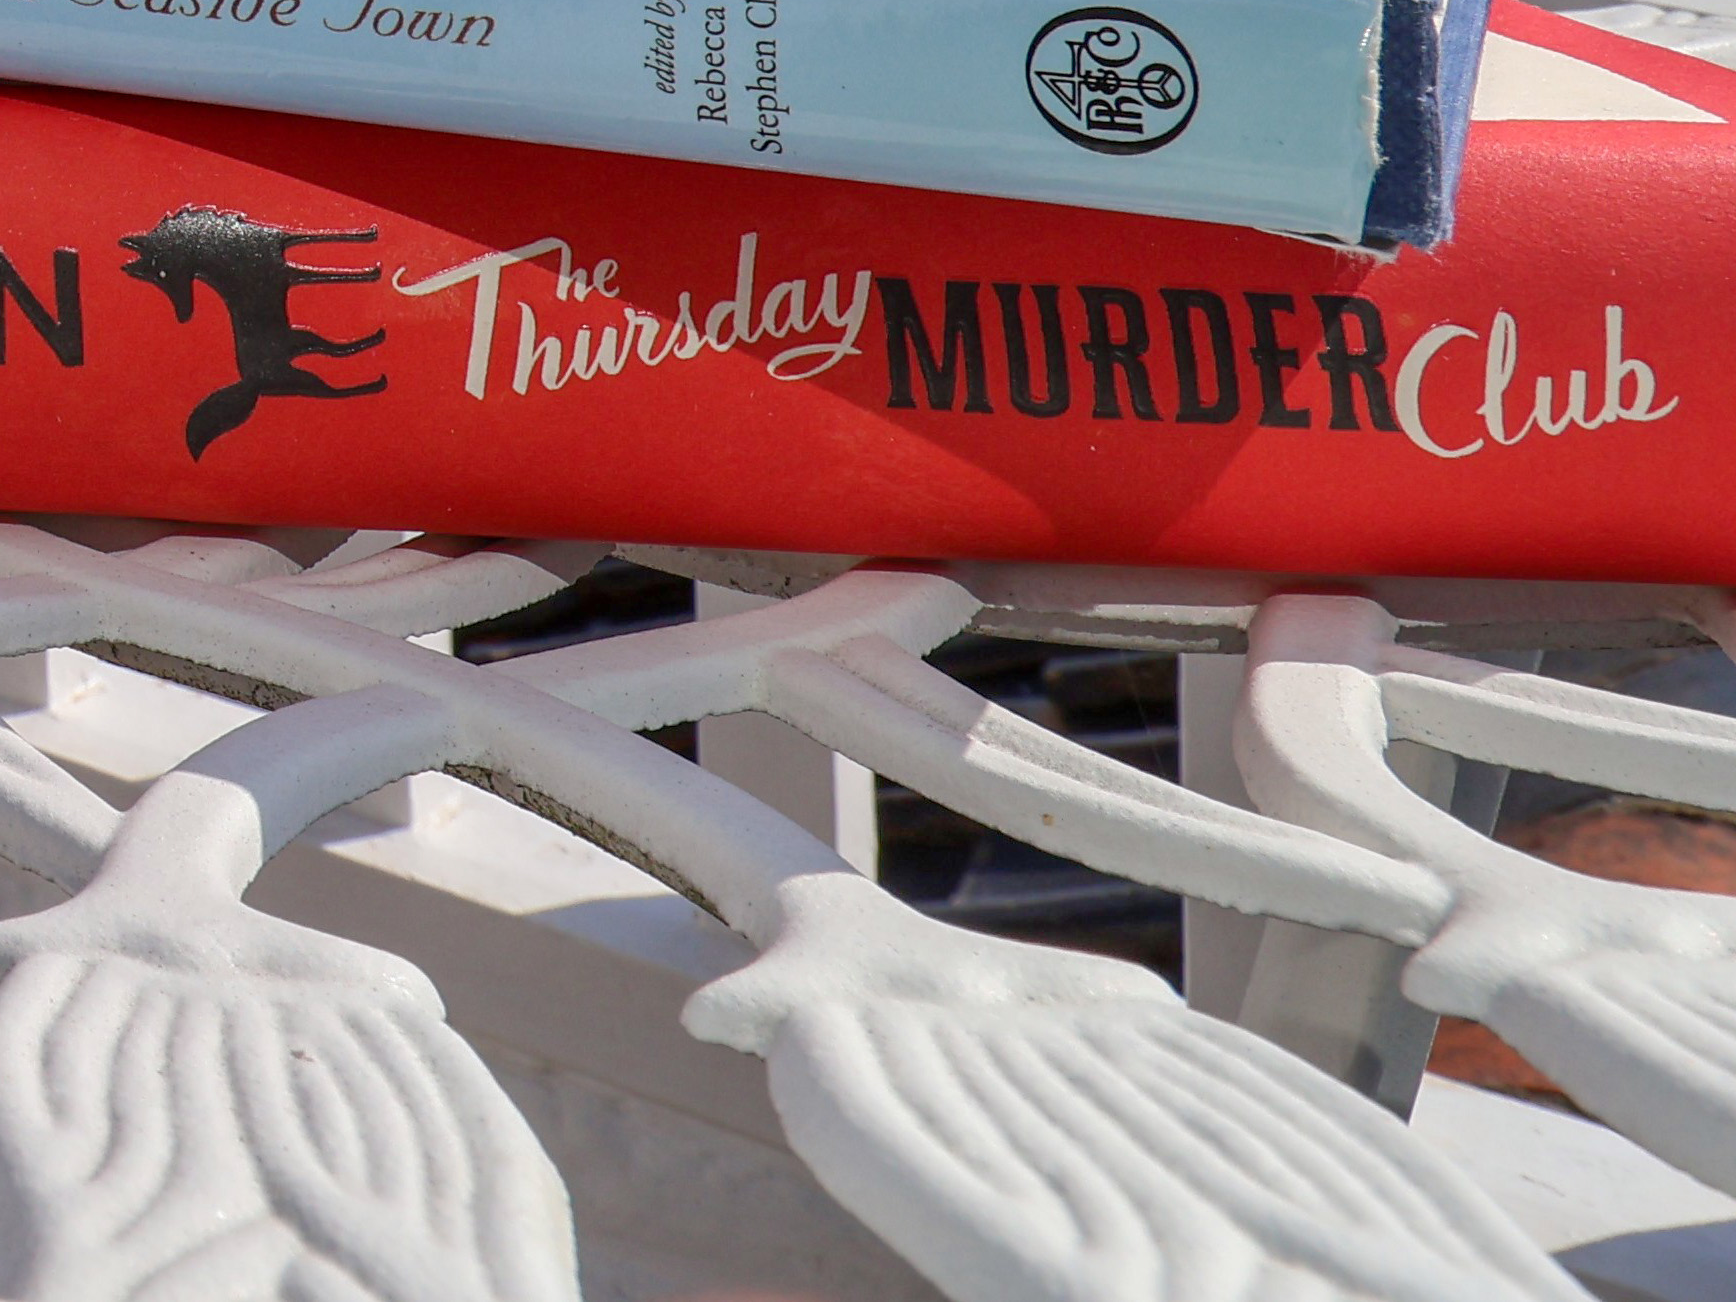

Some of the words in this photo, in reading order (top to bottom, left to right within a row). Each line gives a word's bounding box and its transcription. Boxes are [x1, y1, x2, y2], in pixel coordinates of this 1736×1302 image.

[643, 19, 677, 95] edited
[694, 6, 728, 125] Rebecca
[745, 40, 790, 155] Stephen
[391, 231, 874, 401] Thursday
[873, 276, 1402, 432] MURDER
[1392, 305, 1679, 459] Club
